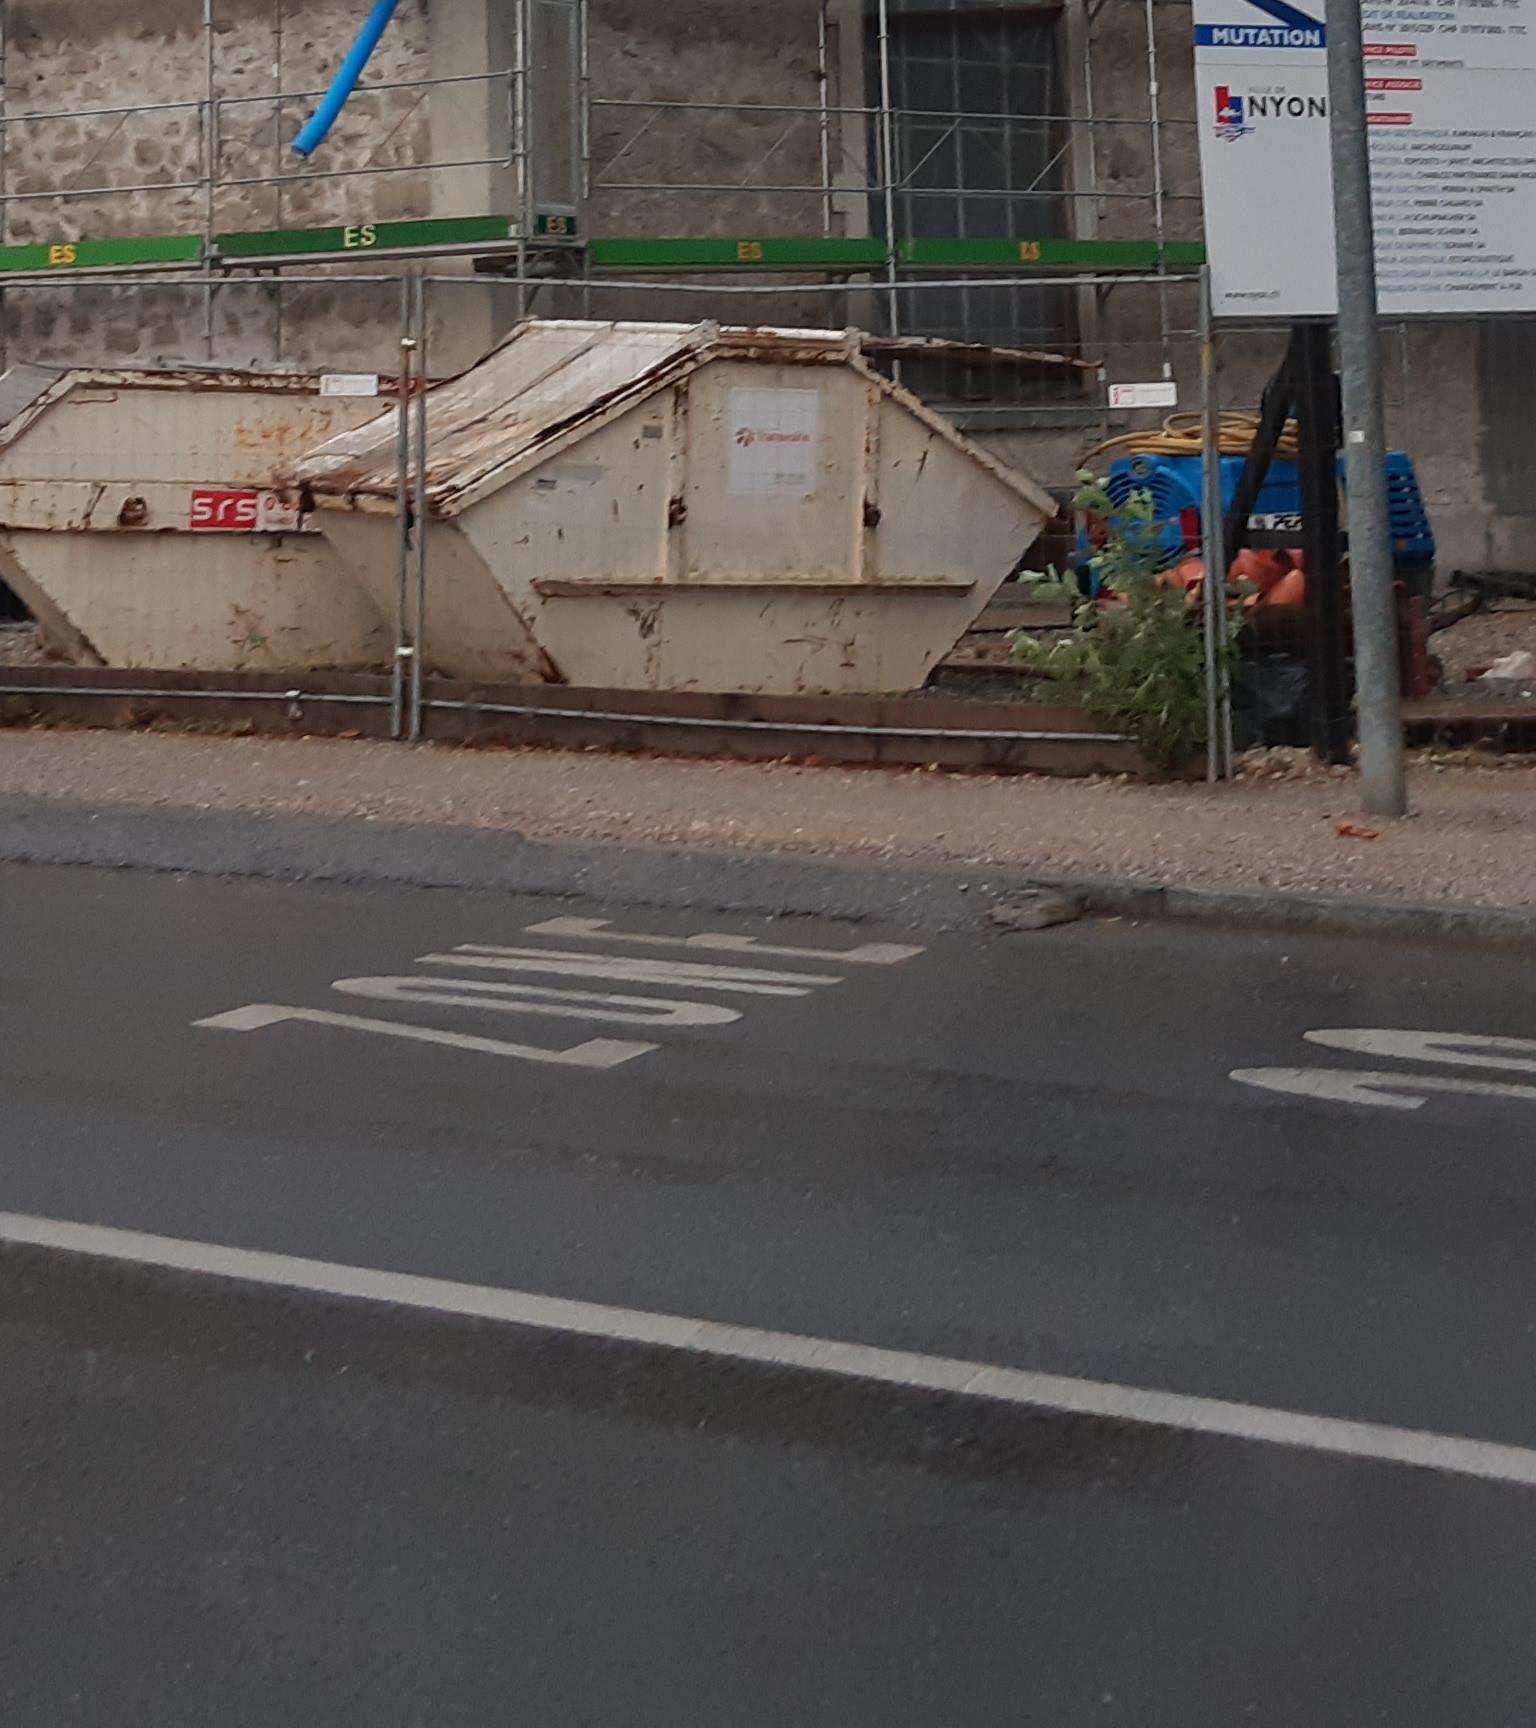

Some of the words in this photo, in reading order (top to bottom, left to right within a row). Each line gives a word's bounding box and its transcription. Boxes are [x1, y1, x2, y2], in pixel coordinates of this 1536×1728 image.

[1211, 27, 1321, 47] MUTATION
[1247, 95, 1327, 118] NYON
[547, 216, 566, 233] ES
[344, 225, 376, 248] ES
[50, 245, 75, 265] ES
[737, 242, 761, 260] ES
[189, 916, 927, 1069] ZONE
